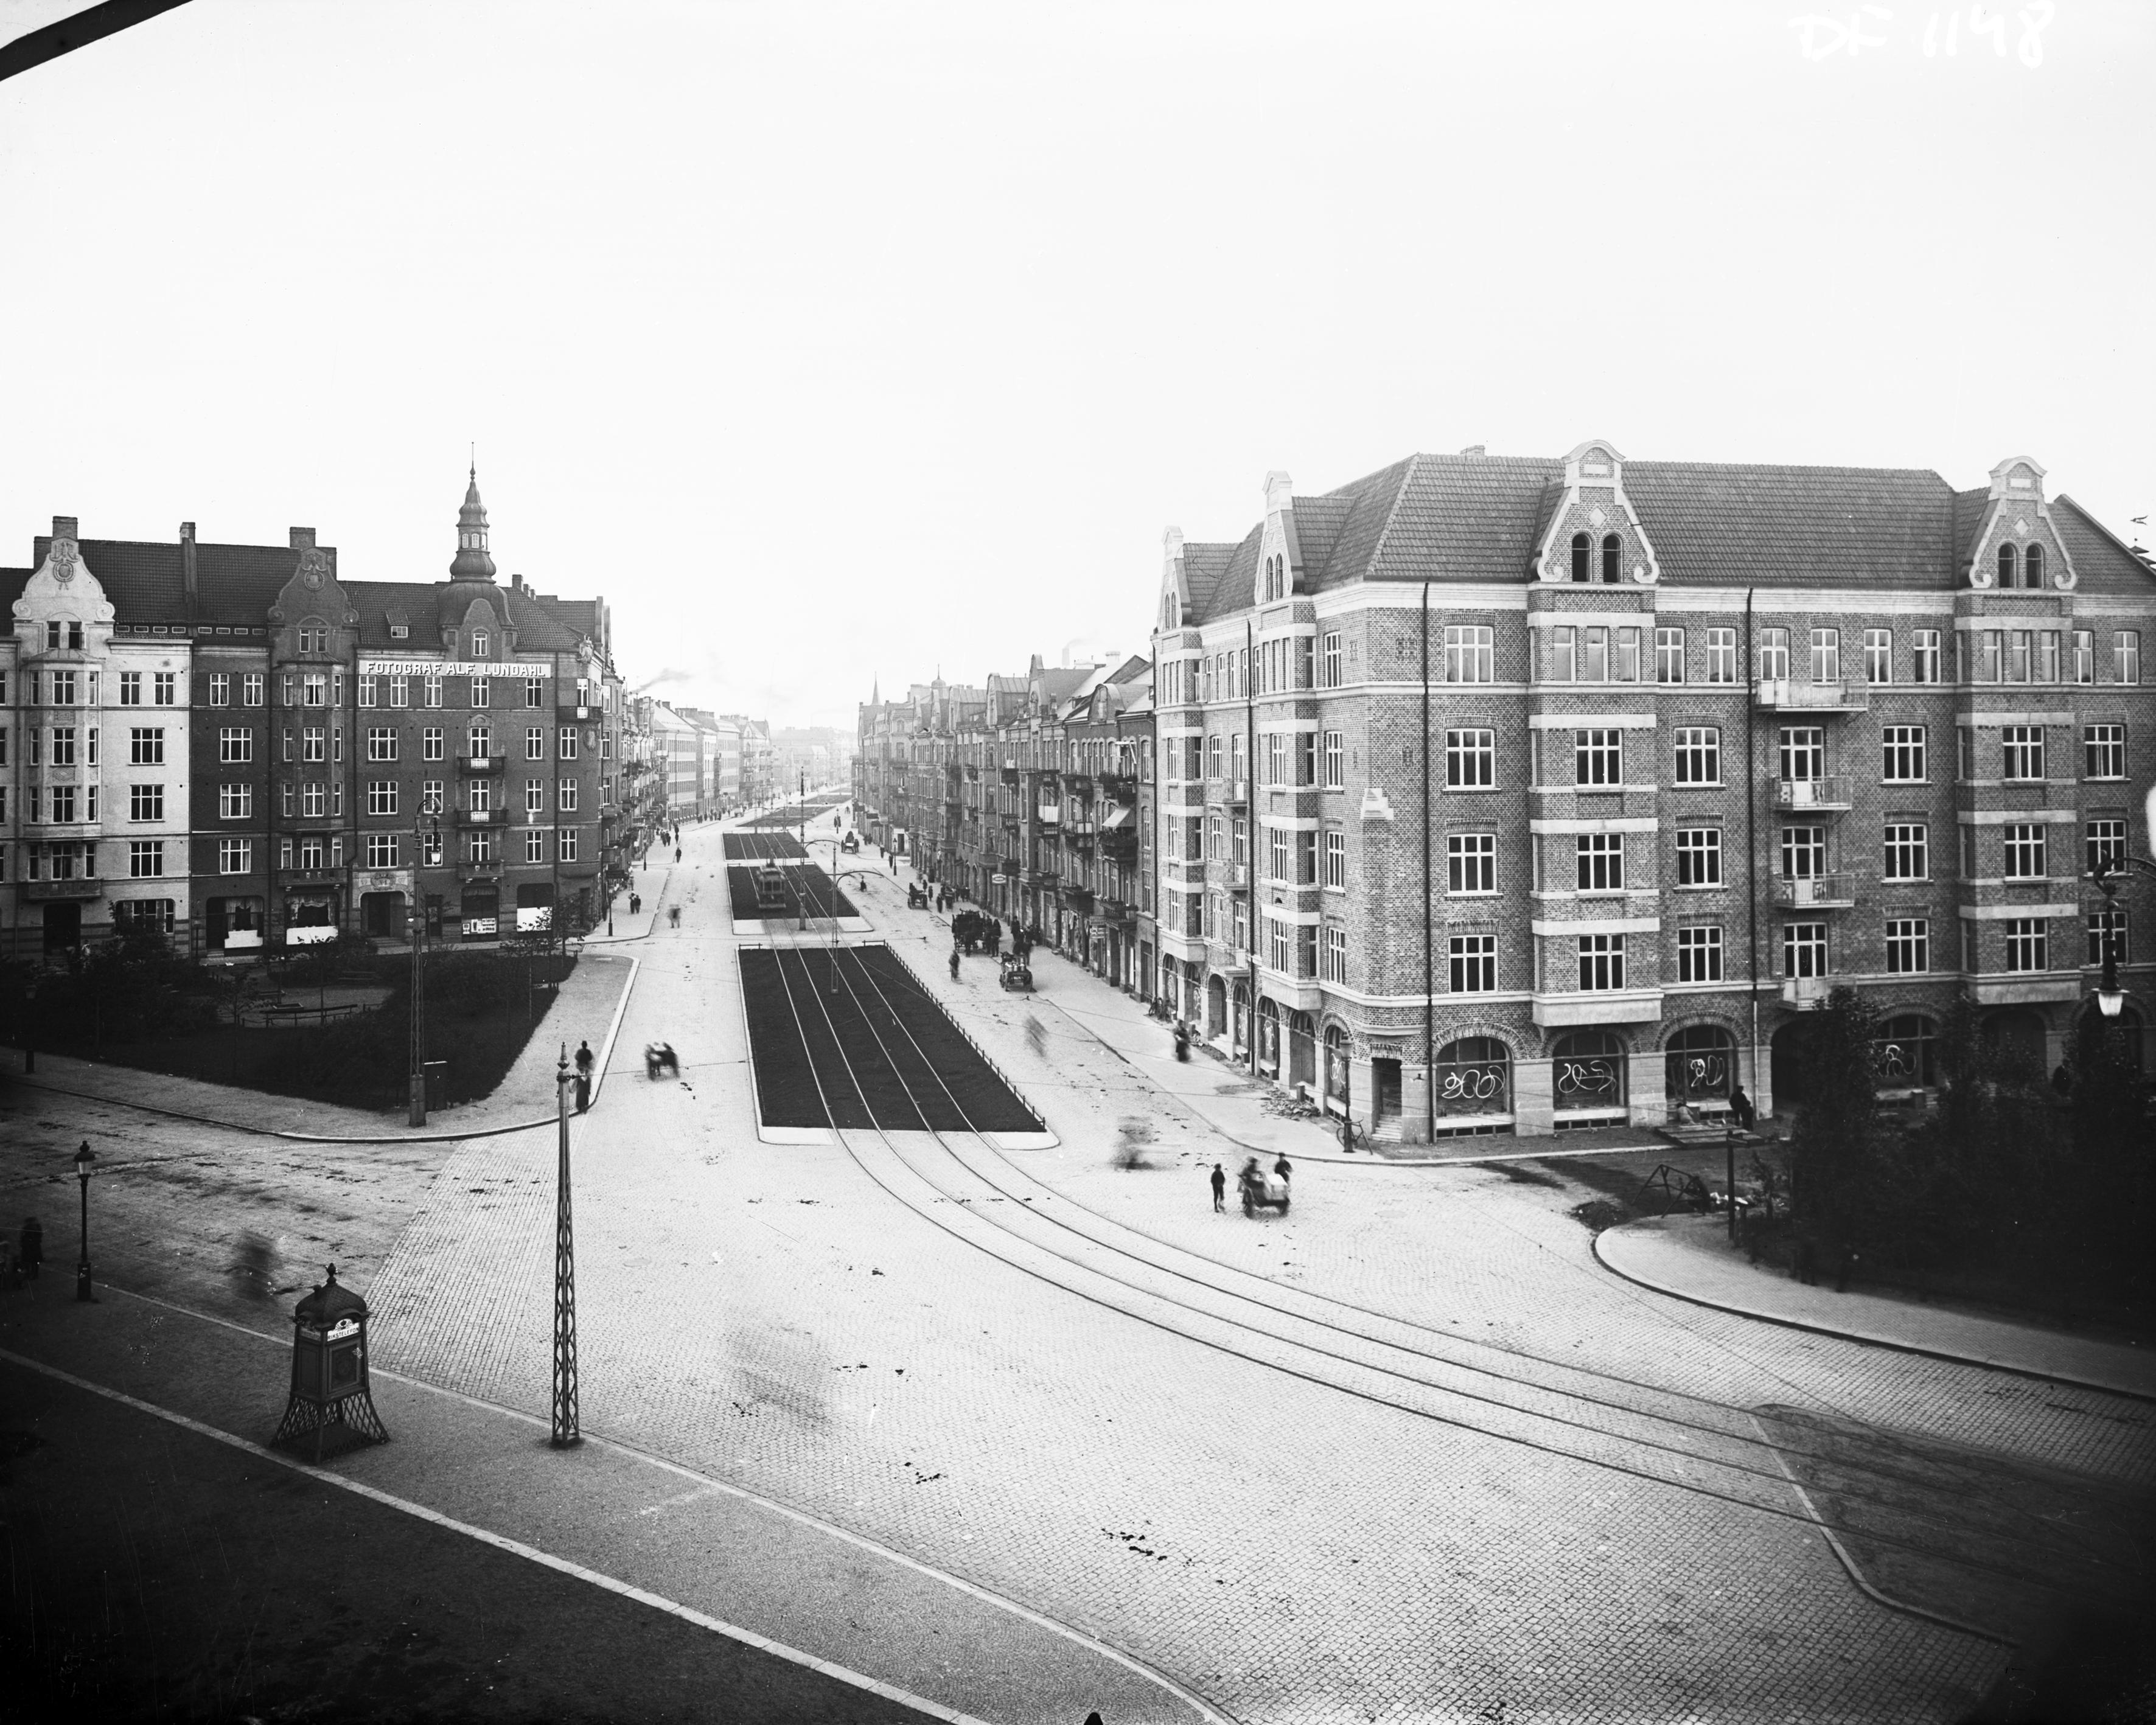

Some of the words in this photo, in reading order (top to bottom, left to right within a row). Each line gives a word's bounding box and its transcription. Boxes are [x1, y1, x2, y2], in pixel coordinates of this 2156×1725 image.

[366, 662, 442, 675] FOTOGRAF
[445, 663, 476, 675] ALF.
[483, 663, 546, 677] LUNDAHL
[327, 1327, 360, 1340] RIKSTELEFON
